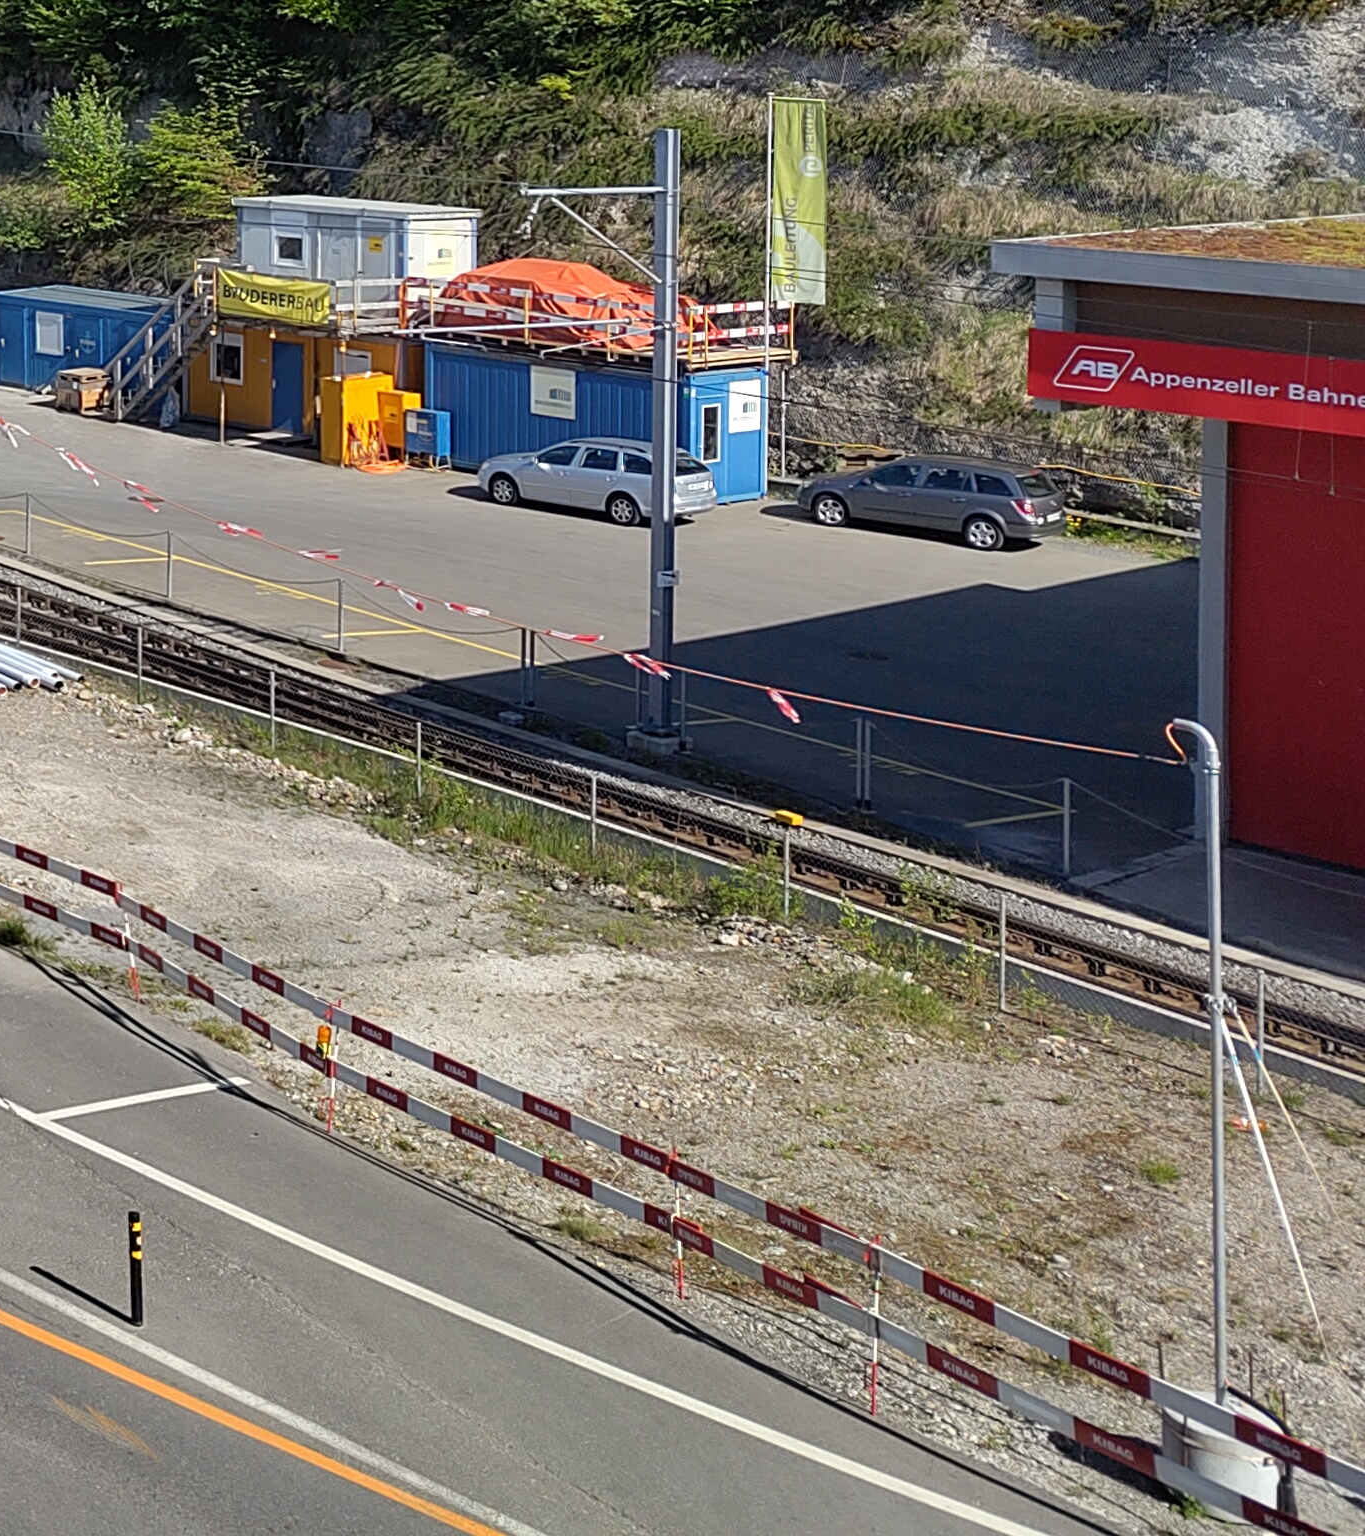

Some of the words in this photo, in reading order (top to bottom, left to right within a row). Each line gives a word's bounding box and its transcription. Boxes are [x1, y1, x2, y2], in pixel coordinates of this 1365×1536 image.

[784, 197, 797, 293] BAULEITUNG
[223, 285, 325, 313] BRUDERERBAU
[1072, 360, 1119, 379] AB
[1130, 367, 1279, 398] Appenzeller
[361, 1025, 382, 1041] KIBAG
[444, 1062, 467, 1079] KIBAG
[376, 1086, 398, 1102] KIBAG
[534, 1103, 560, 1121] KIBAG
[461, 1126, 485, 1144] KIBAG
[634, 1147, 661, 1166] KIBAG
[554, 1168, 581, 1188] KIBAG
[779, 1214, 808, 1234] KIBAG
[678, 1229, 703, 1247] KIBAG
[775, 1276, 804, 1298] KIBAG
[938, 1285, 976, 1311] KIBAG
[943, 1359, 979, 1385] KIBAG
[1087, 1353, 1129, 1383] KIBAG
[1092, 1432, 1135, 1462] KIBAG
